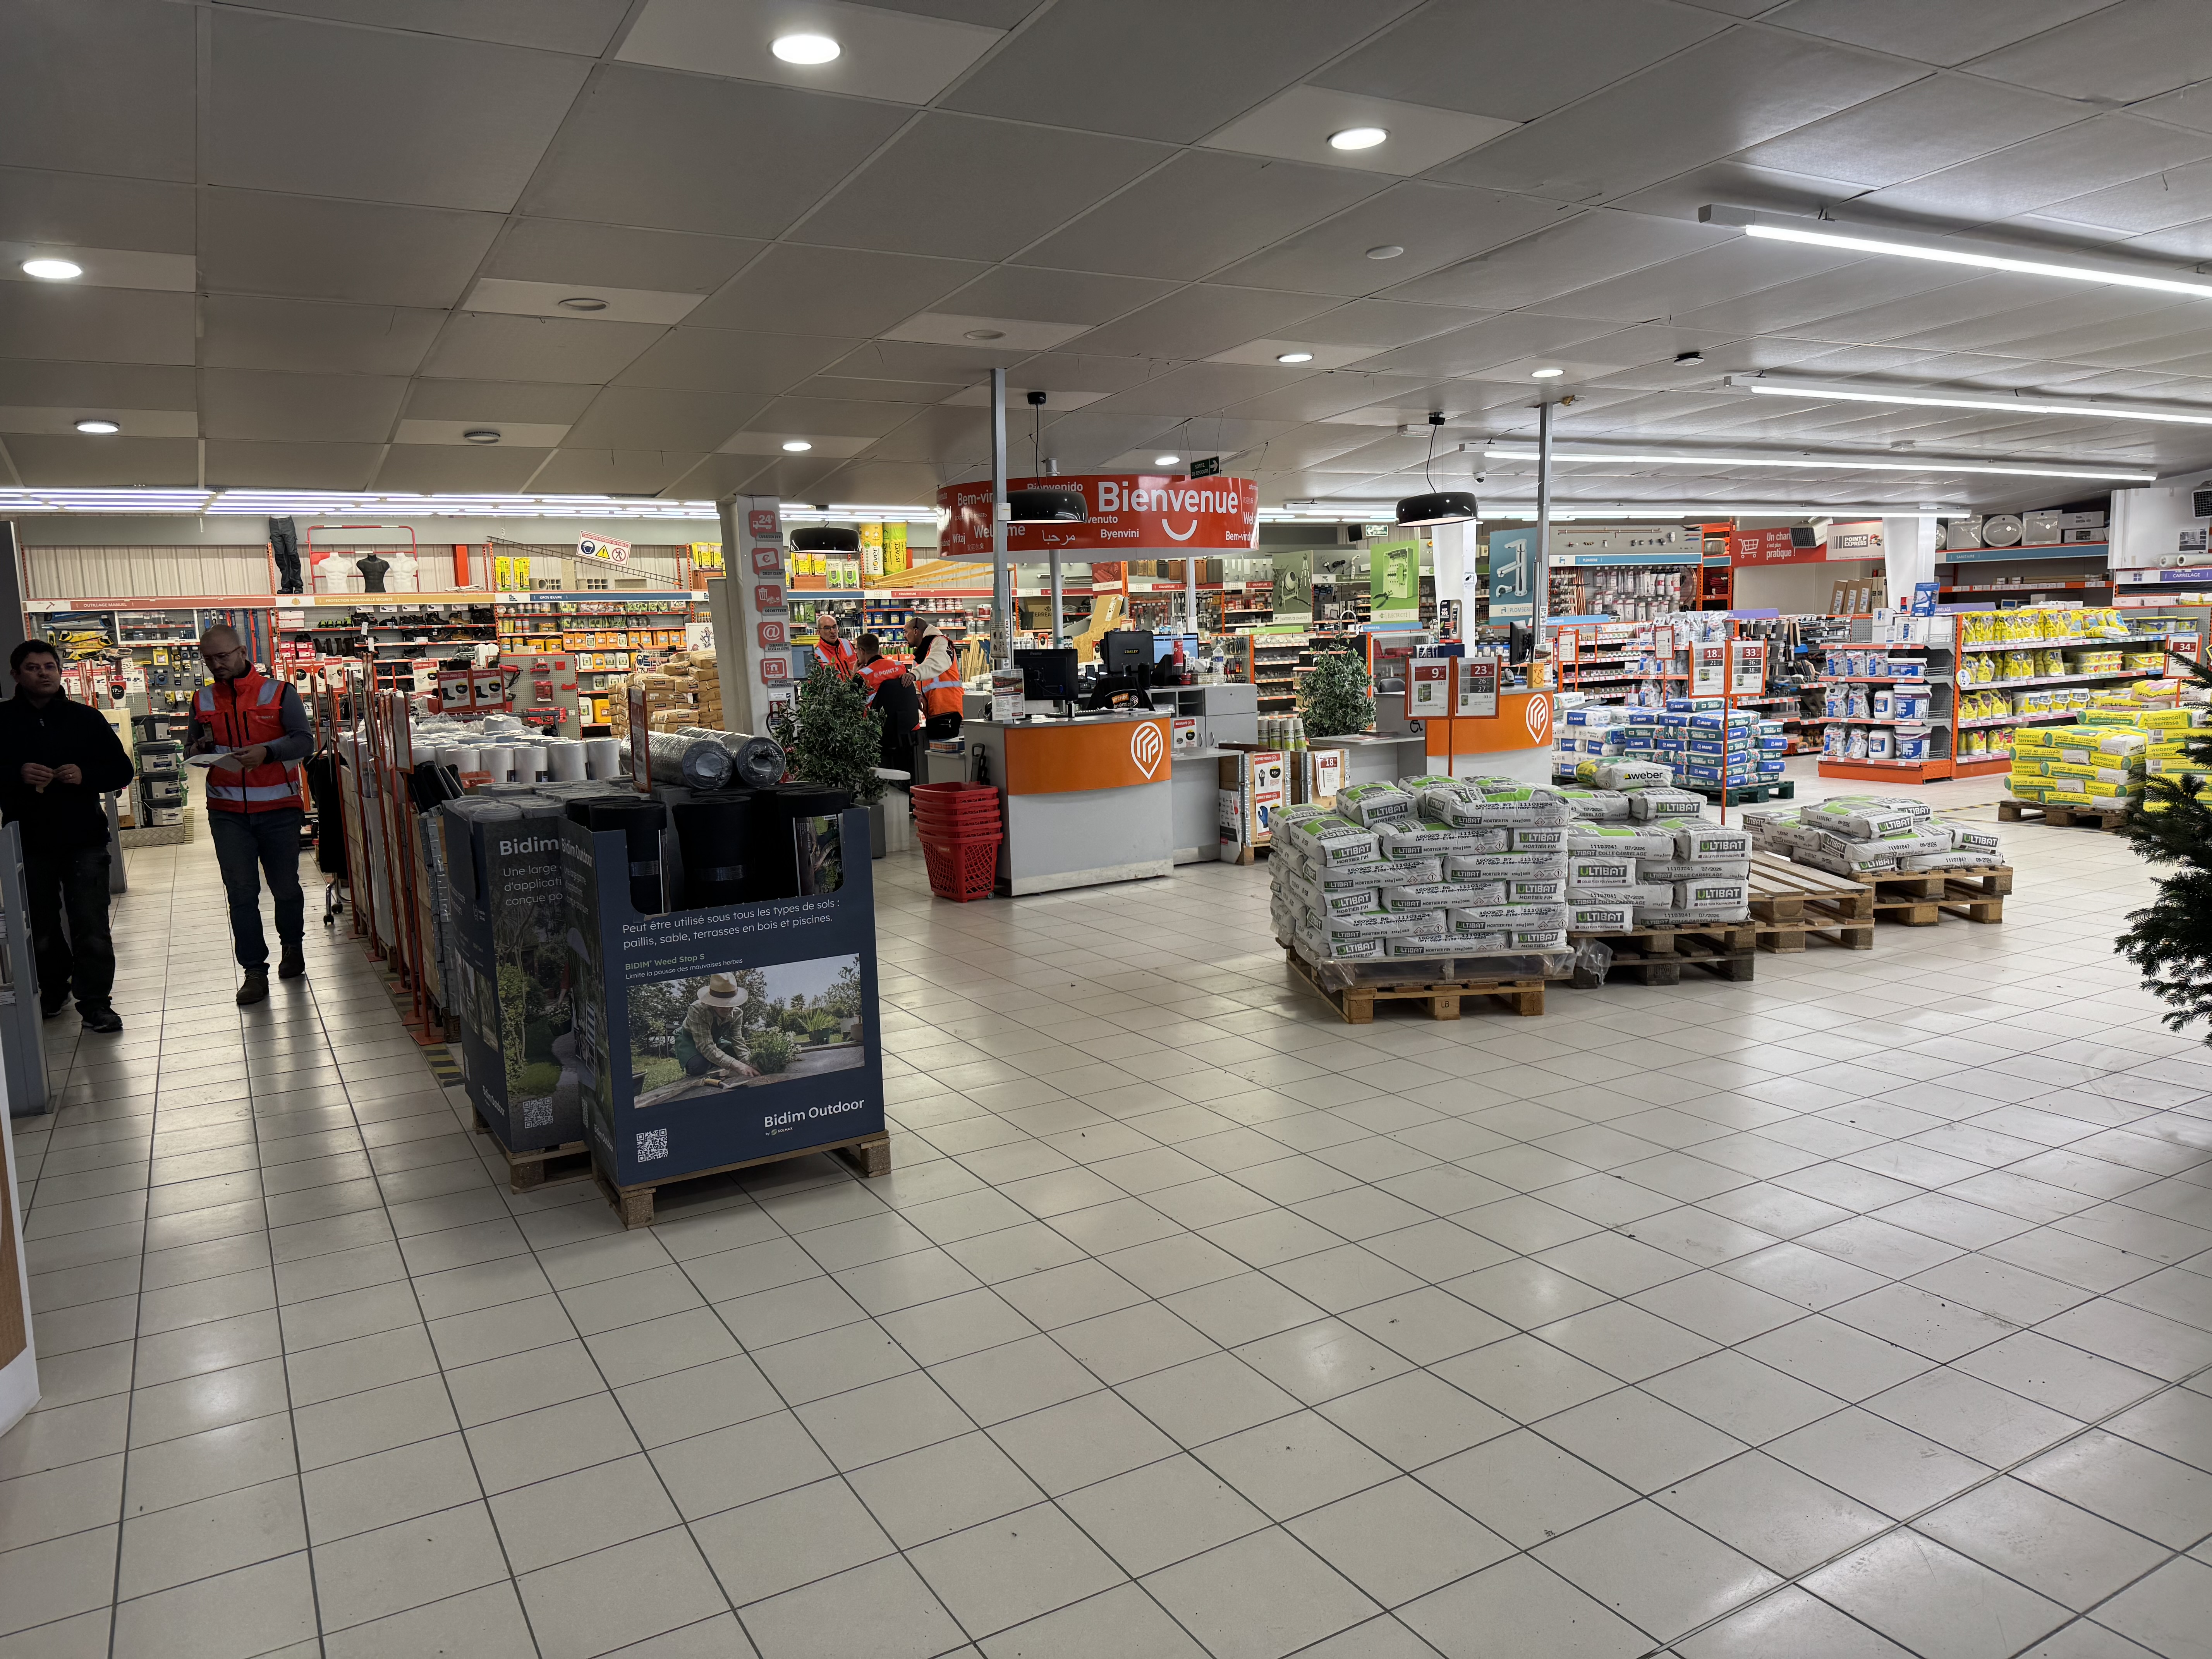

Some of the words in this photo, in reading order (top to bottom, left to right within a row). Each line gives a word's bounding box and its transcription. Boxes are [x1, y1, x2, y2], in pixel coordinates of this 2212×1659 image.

[1098, 481, 1238, 514] Bienvenue
[1085, 515, 1118, 524] venuto
[974, 525, 1025, 539] Welme
[1042, 529, 1075, 545] مرحبا
[1101, 529, 1139, 538] Byenvini
[1767, 532, 1775, 541] Un
[953, 533, 965, 544] Witaj
[1766, 549, 1791, 560] pratique
[1793, 548, 1796, 556] !
[879, 667, 899, 676] POINT.P
[1432, 668, 1439, 678] 9
[1475, 666, 1487, 675] 23
[1326, 758, 1334, 766] 18
[1658, 803, 1698, 812] ULTIBAT
[1522, 833, 1560, 842] ULTIBAT
[500, 836, 559, 855] Bidim
[1702, 842, 1743, 850] ULTIBAT
[1333, 844, 1370, 859] ULTIBAT
[1337, 856, 1359, 864] MORTIER
[503, 868, 525, 877] Une
[529, 865, 556, 875] large
[1580, 867, 1625, 876] ULTIBAT
[505, 876, 562, 892] d'applicati
[1518, 884, 1556, 893] ULTIBAT
[1698, 889, 1739, 898] ULTIBAT
[506, 895, 545, 905] conçue
[1332, 894, 1370, 908] ULTIBAT
[623, 923, 647, 933] Peut
[650, 921, 671, 930] être
[675, 915, 704, 927] utilisé
[708, 914, 730, 923] sous
[733, 910, 755, 920] tous
[757, 908, 771, 917] les
[773, 905, 800, 916] types
[802, 902, 814, 911] de
[817, 899, 835, 909] sols
[1578, 912, 1622, 922] ULTIBAT
[624, 937, 657, 950] paillis,
[660, 933, 690, 944] sable,
[694, 926, 740, 939] terrasses
[757, 921, 778, 931] bois
[780, 919, 790, 927] et
[793, 915, 832, 928] piscines.
[654, 957, 677, 966] Weed
[680, 954, 697, 963] Stop
[690, 962, 721, 970] mauvaises
[764, 1111, 805, 1127] Bidim
[809, 1099, 864, 1118] Outdoor
